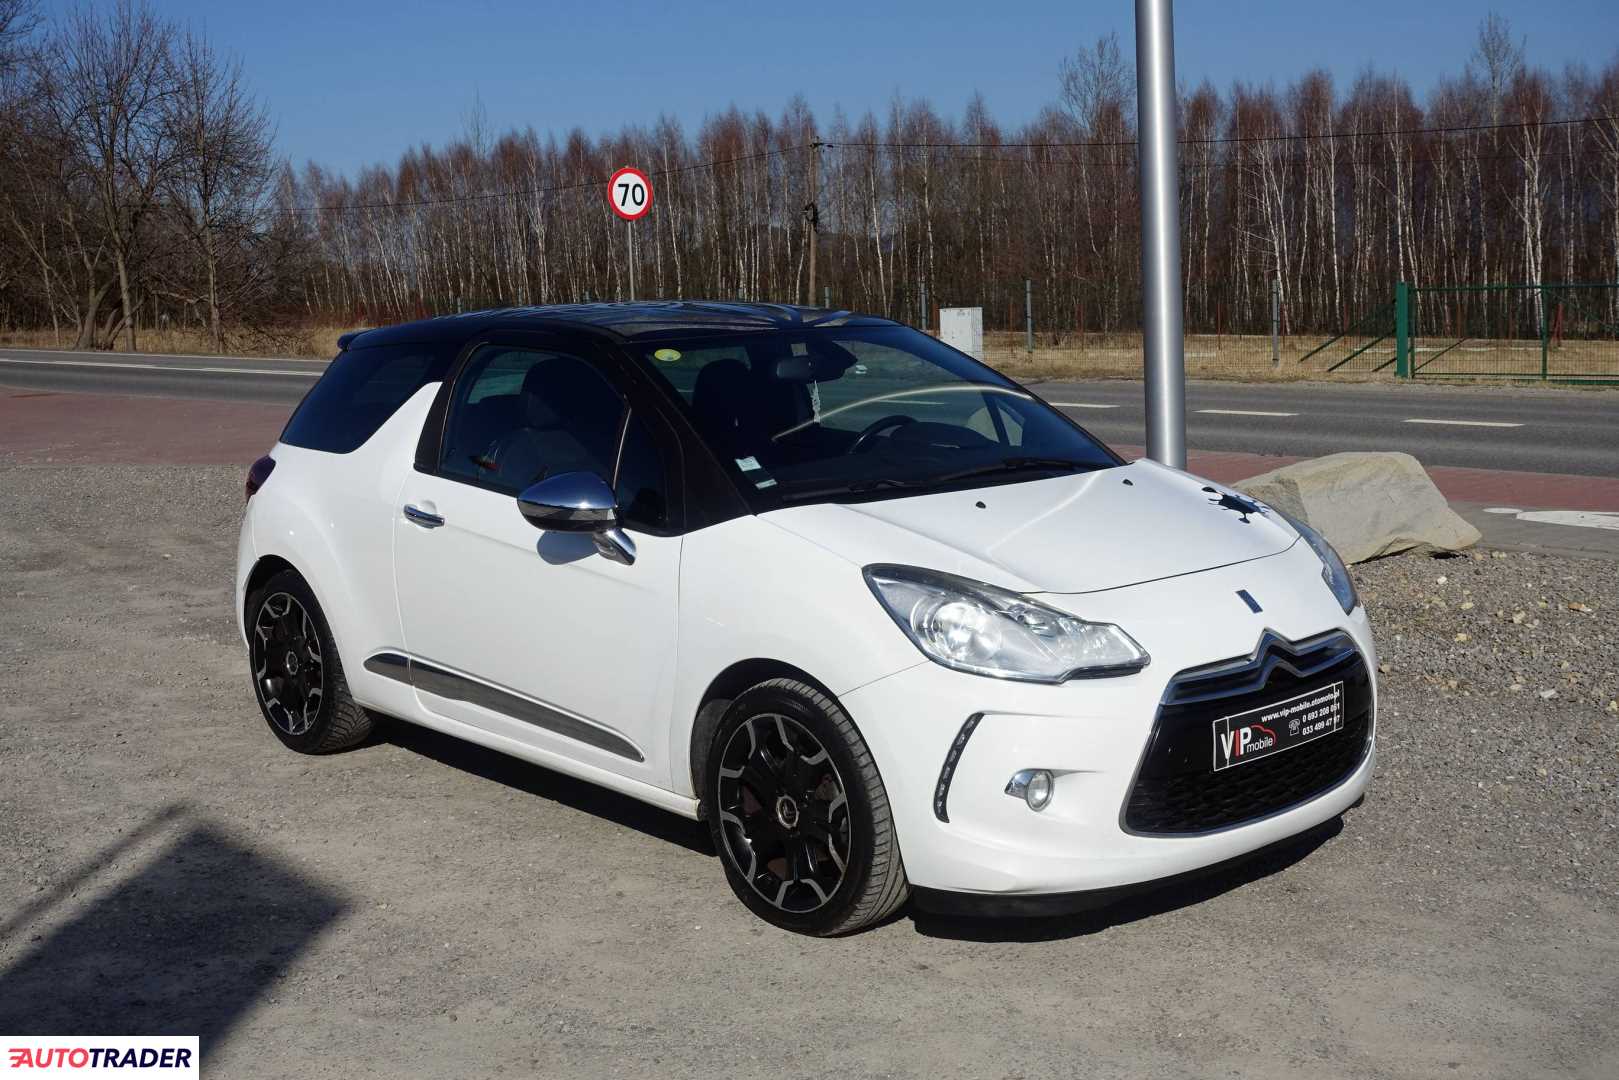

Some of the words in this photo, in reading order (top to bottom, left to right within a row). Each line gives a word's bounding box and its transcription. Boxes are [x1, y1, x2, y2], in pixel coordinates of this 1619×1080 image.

[617, 183, 645, 207] 70
[1302, 714, 1307, 723] 0
[1220, 726, 1252, 760] VIP
[1246, 736, 1274, 753] mobile
